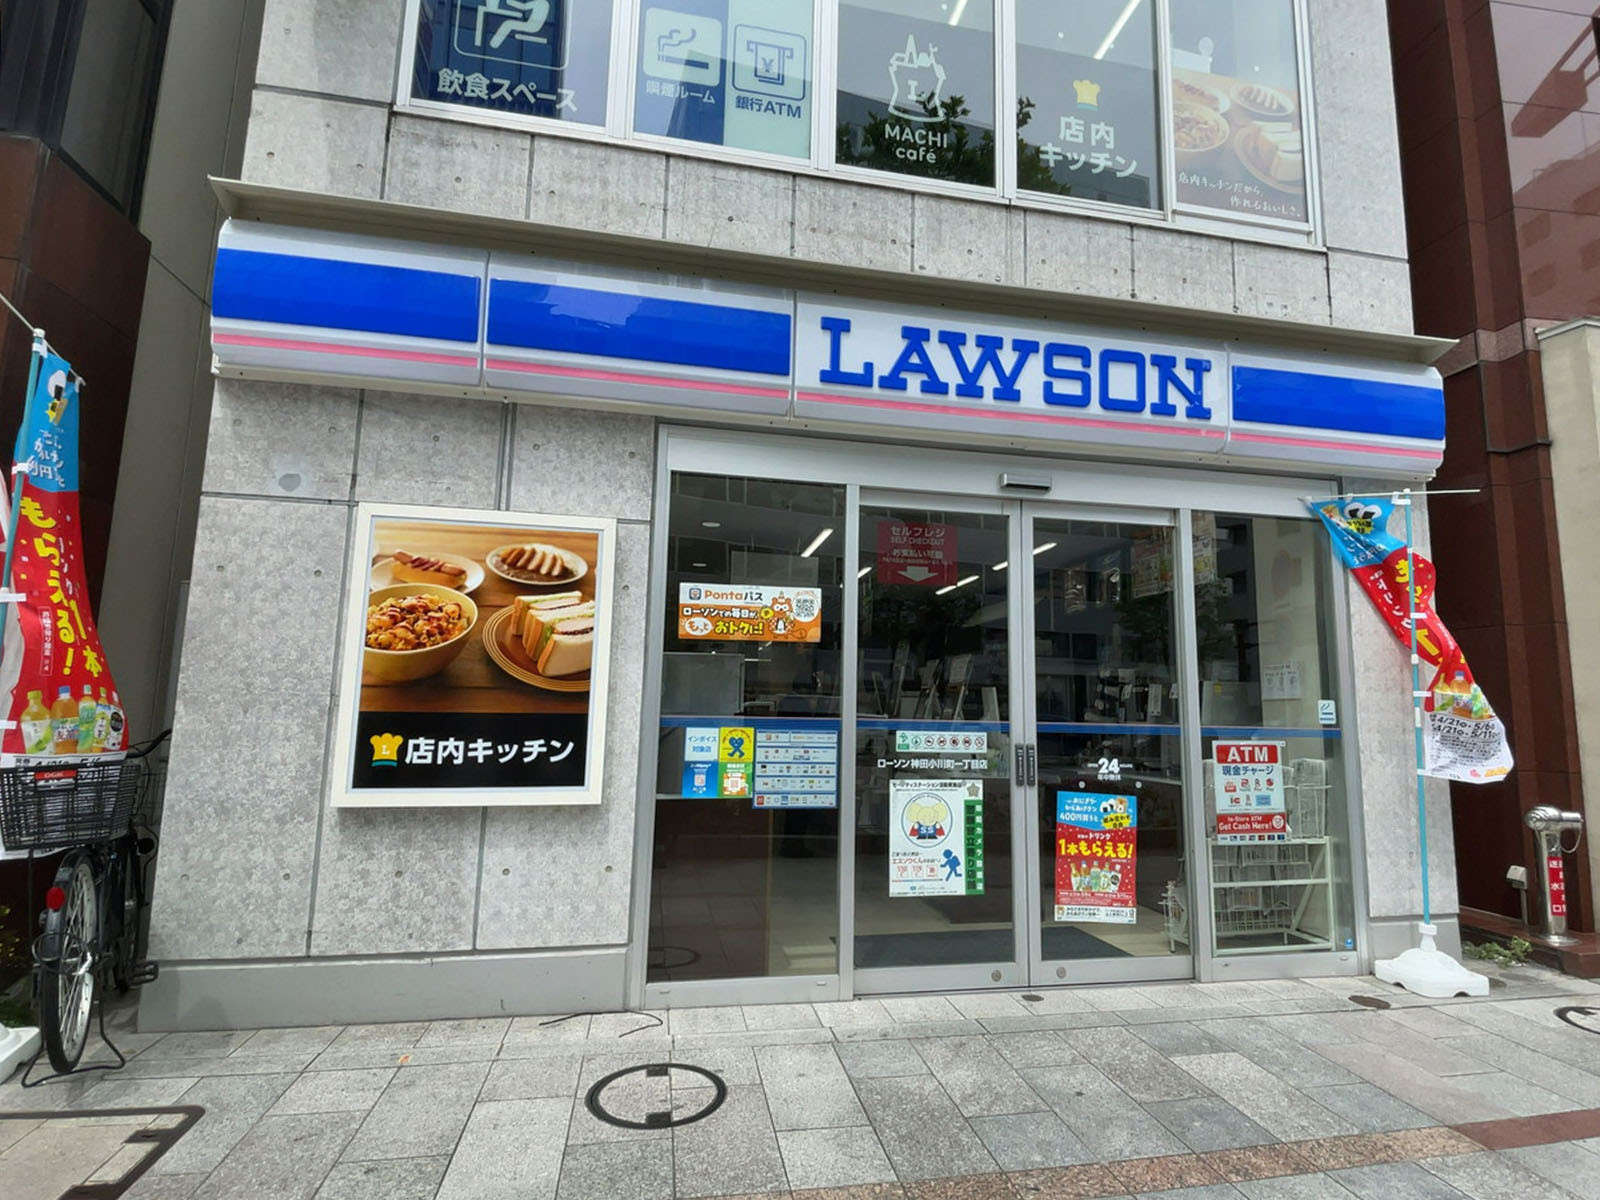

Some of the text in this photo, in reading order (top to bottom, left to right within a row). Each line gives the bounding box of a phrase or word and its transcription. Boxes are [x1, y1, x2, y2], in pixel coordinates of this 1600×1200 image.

[437, 67, 578, 112] 飲食スペース
[735, 95, 801, 118] 銀行ATM
[885, 123, 948, 148] MACHI
[1059, 116, 1114, 149] 店内
[895, 147, 937, 163] café
[1040, 142, 1137, 178] キッチン
[819, 316, 1212, 420] LAWSON
[891, 525, 945, 537] セルフレジ
[688, 620, 709, 632] もっと
[405, 737, 575, 765] 店内キッチン
[1227, 746, 1269, 762] ATM
[877, 759, 988, 770] ローソン神田小川町一丁目店
[1098, 758, 1120, 774] 24
[1222, 766, 1274, 776] 現金チャージ
[1218, 822, 1272, 830] Get Cash Here!
[1058, 839, 1133, 859] 1本もらえる!
